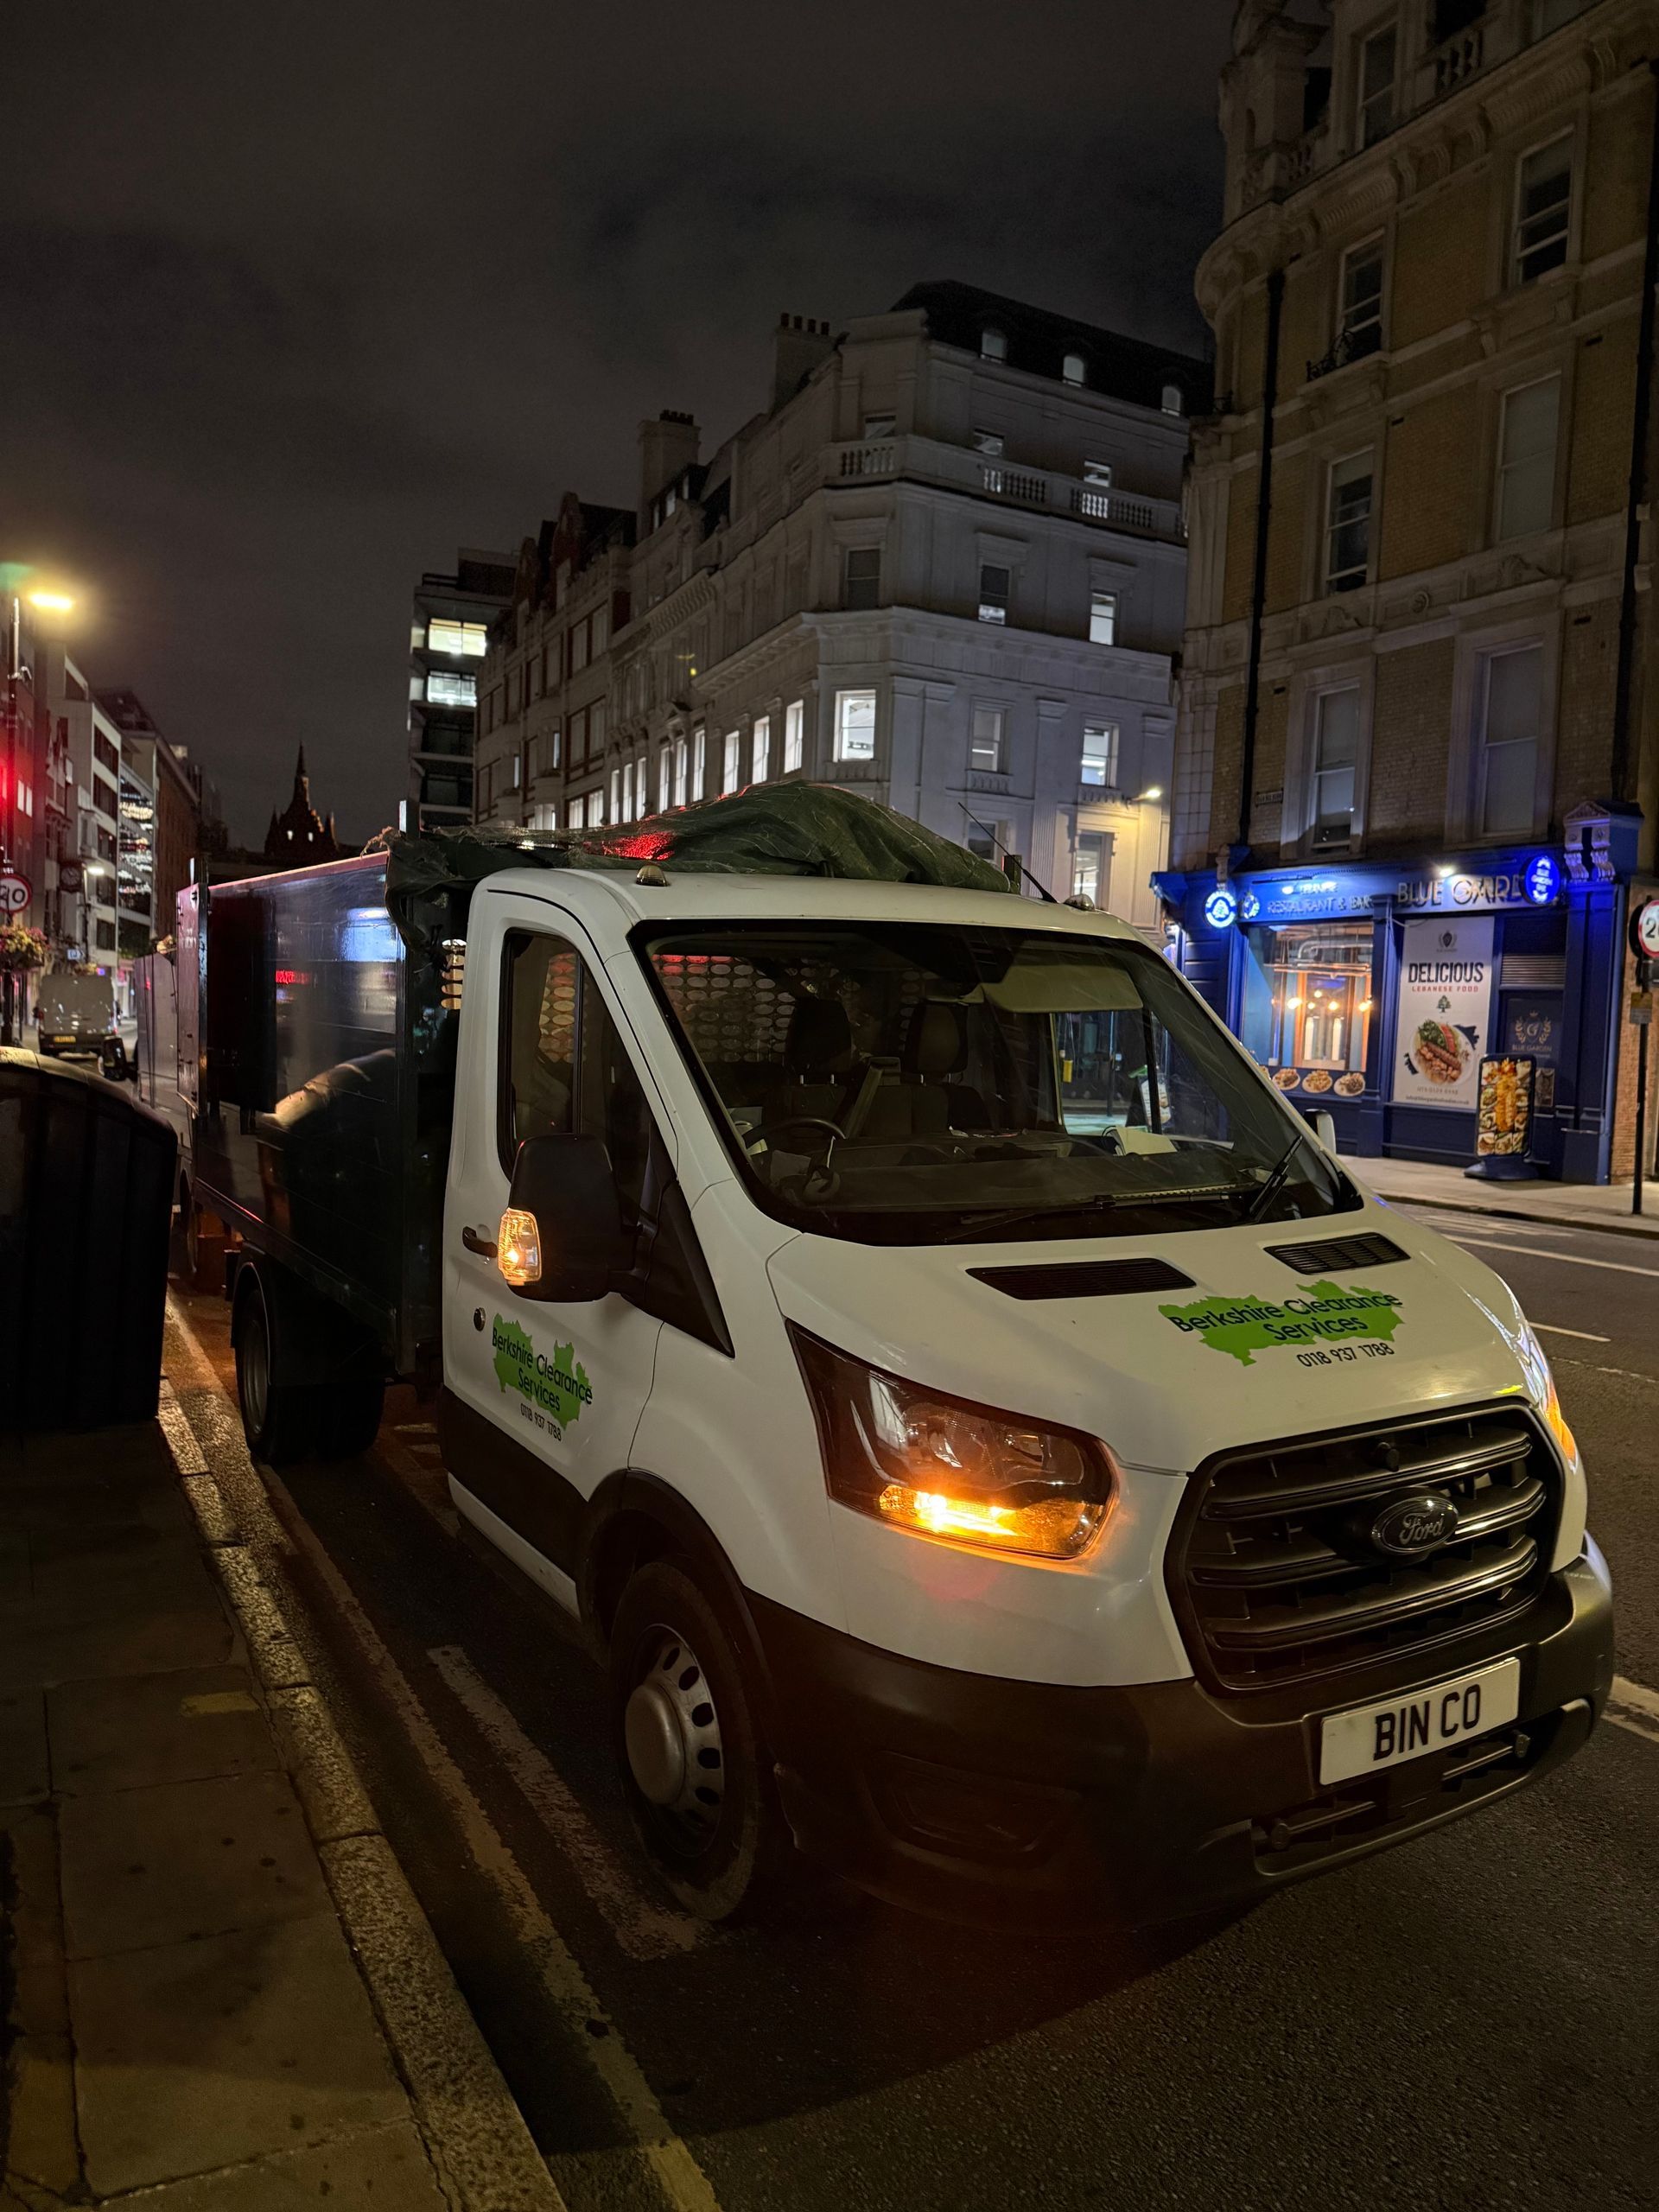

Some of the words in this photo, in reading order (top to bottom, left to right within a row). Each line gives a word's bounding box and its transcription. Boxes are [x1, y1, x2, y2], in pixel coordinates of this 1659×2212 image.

[0, 885, 26, 904] 20
[1398, 880, 1445, 905] BLUE
[1645, 918, 1659, 939] 2
[1408, 962, 1484, 983] DELICIOUS
[1169, 1305, 1283, 1332] Berkshire
[1284, 1294, 1403, 1314] Clearance
[1263, 1314, 1369, 1341] Services
[492, 1327, 534, 1369] Berkshire
[536, 1354, 593, 1405] Clearance
[1296, 1352, 1332, 1368] 0118
[1332, 1347, 1357, 1362] 937
[1357, 1343, 1395, 1357] 1788
[518, 1367, 561, 1412] Services
[520, 1403, 533, 1423] 0118
[534, 1414, 545, 1429] 937
[547, 1421, 562, 1442] 1788
[1399, 1513, 1445, 1545] Ford
[1373, 1700, 1430, 1762] BIN
[1440, 1684, 1481, 1738] CO
